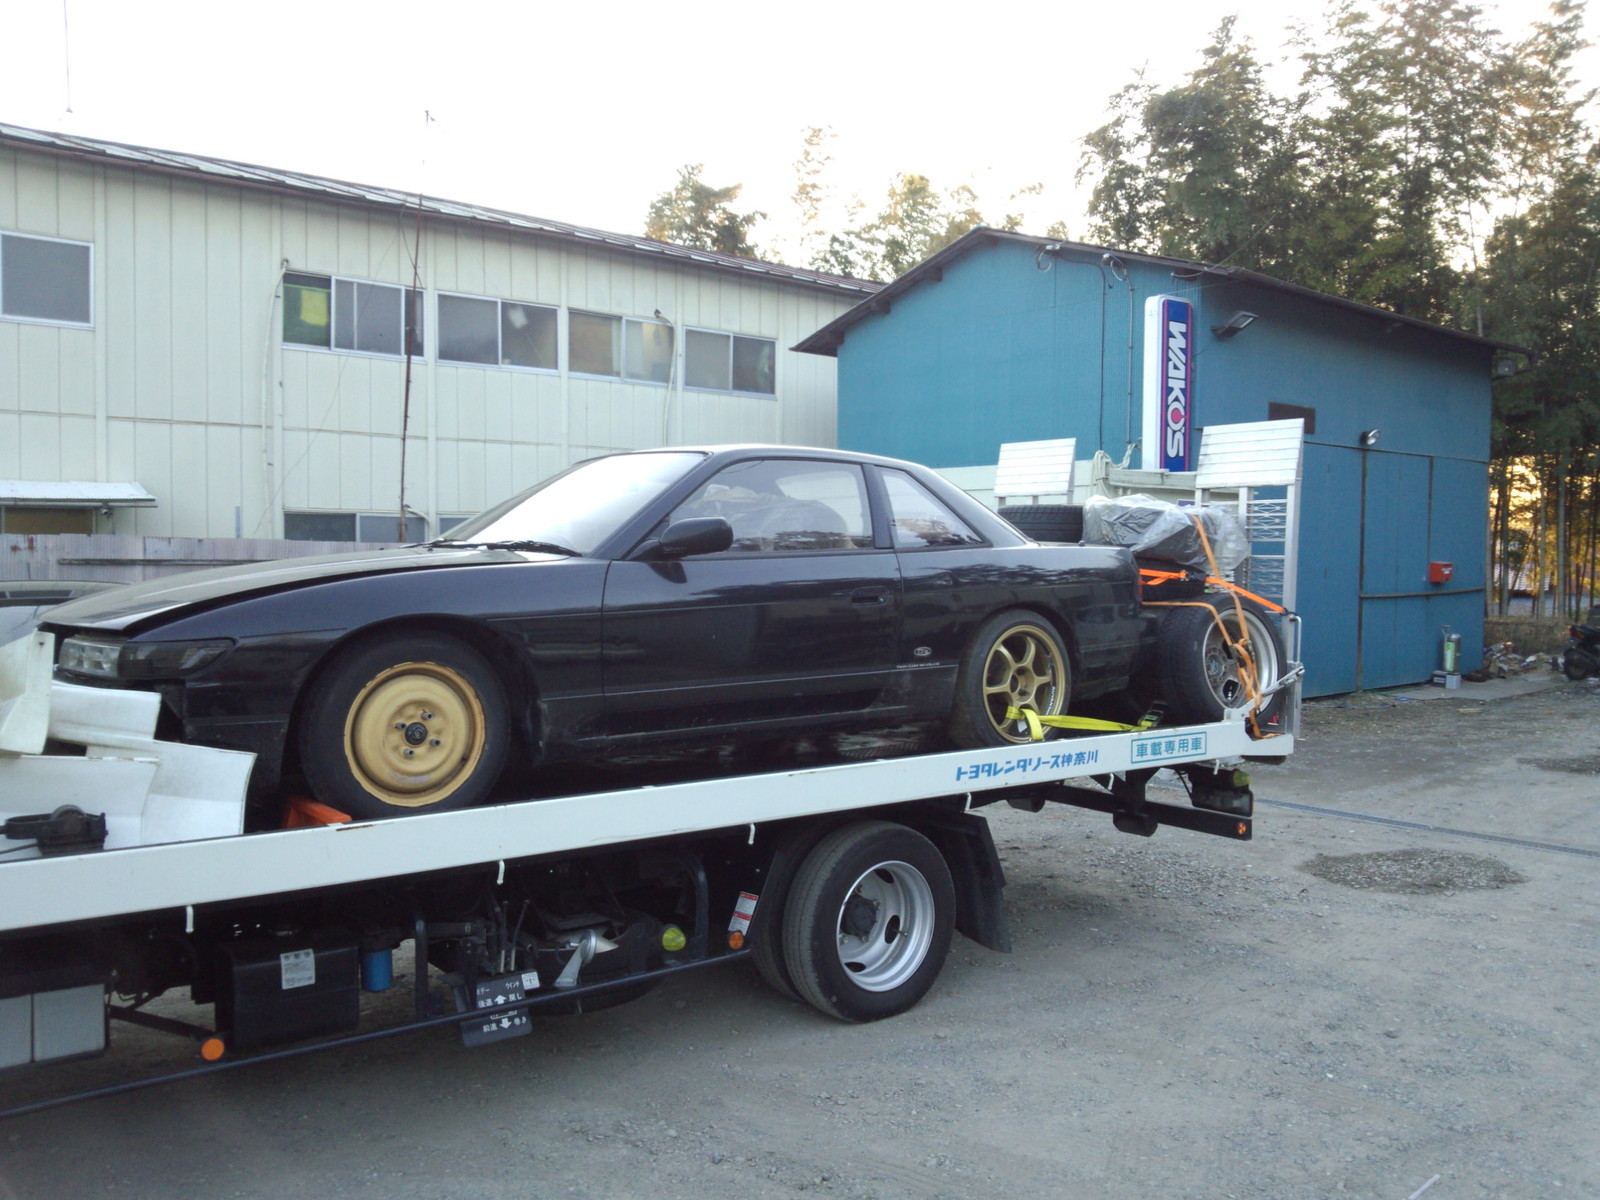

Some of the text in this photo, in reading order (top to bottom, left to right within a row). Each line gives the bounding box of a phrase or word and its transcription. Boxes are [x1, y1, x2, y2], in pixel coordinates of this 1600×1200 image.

[1135, 736, 1203, 758] 車載専用車
[955, 749, 1099, 781] トヨタレンタリース神奈川
